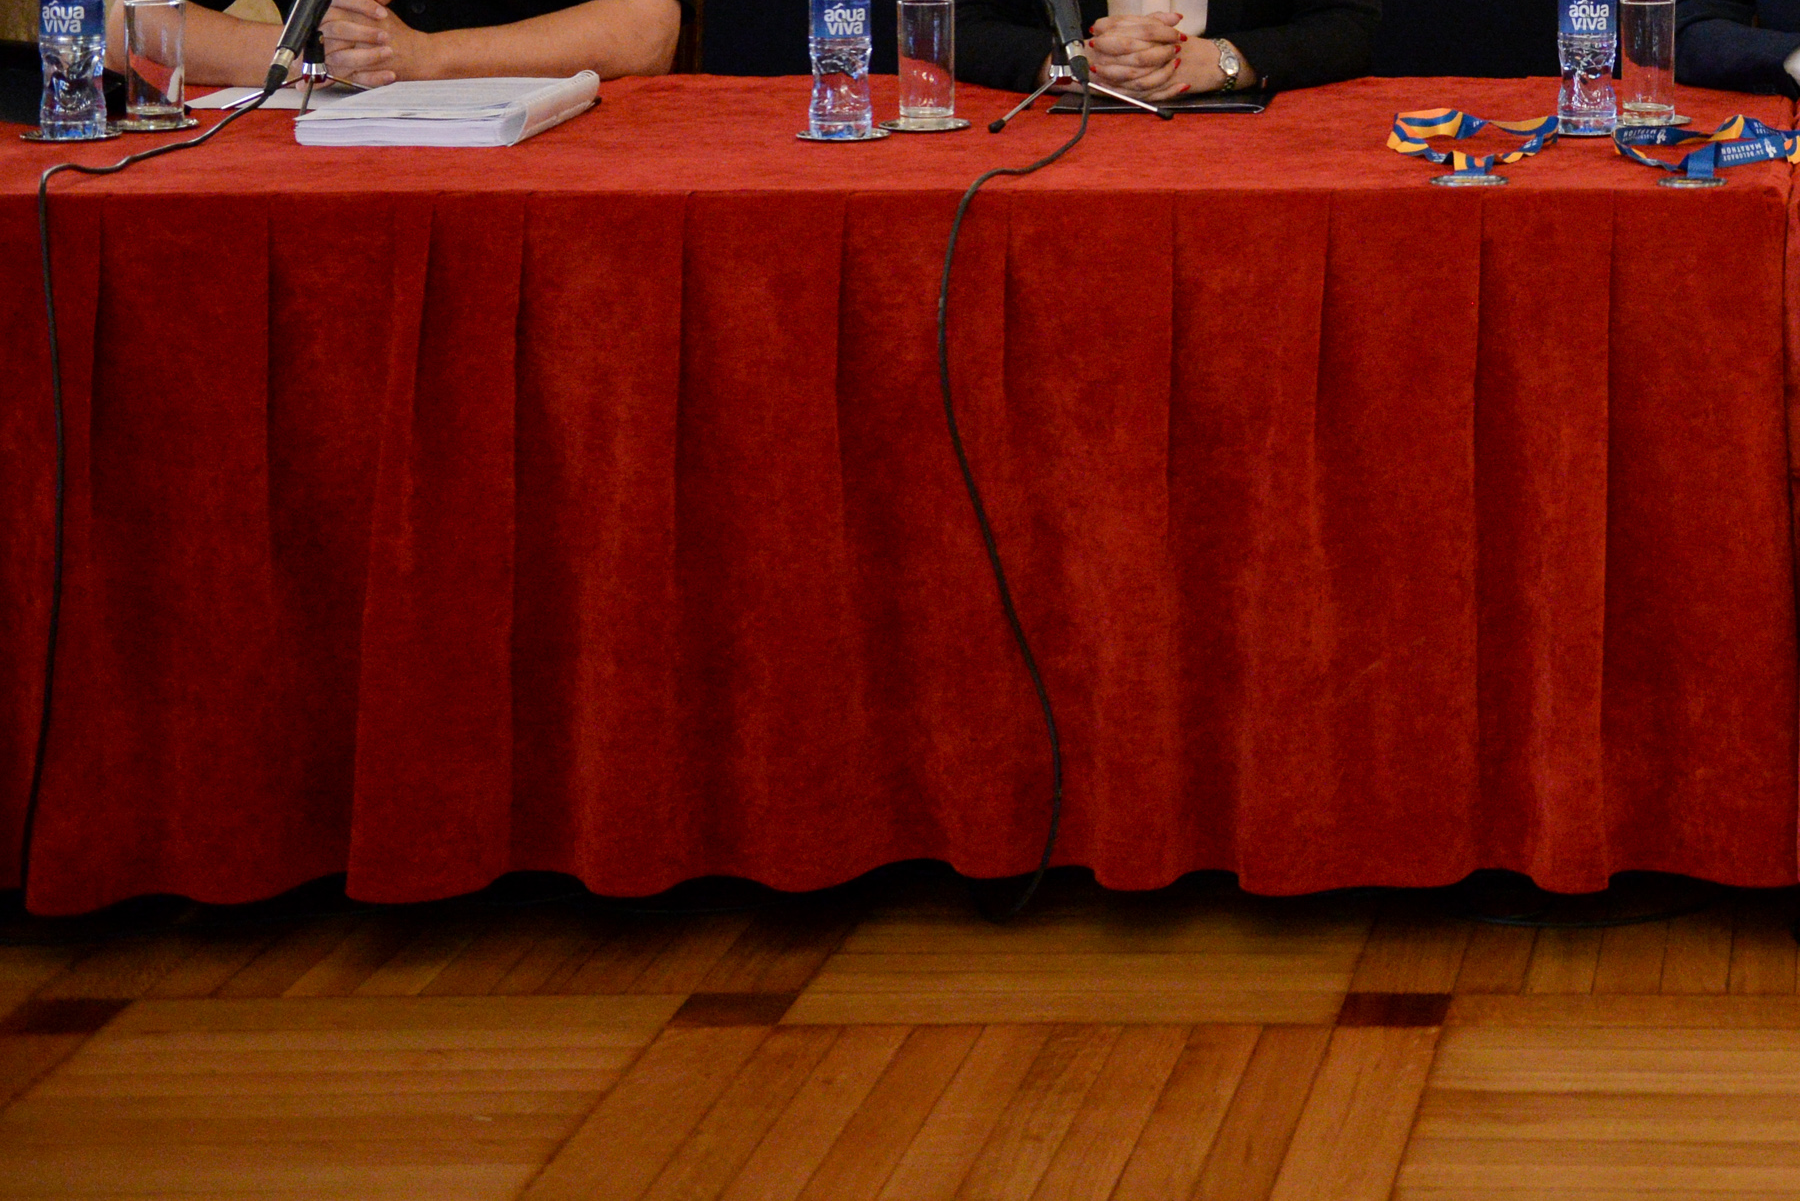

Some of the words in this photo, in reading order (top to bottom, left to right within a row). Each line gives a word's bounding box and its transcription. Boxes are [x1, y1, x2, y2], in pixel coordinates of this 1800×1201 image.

[44, 19, 81, 33] viva
[827, 21, 863, 35] viva
[1571, 17, 1607, 30] viva
